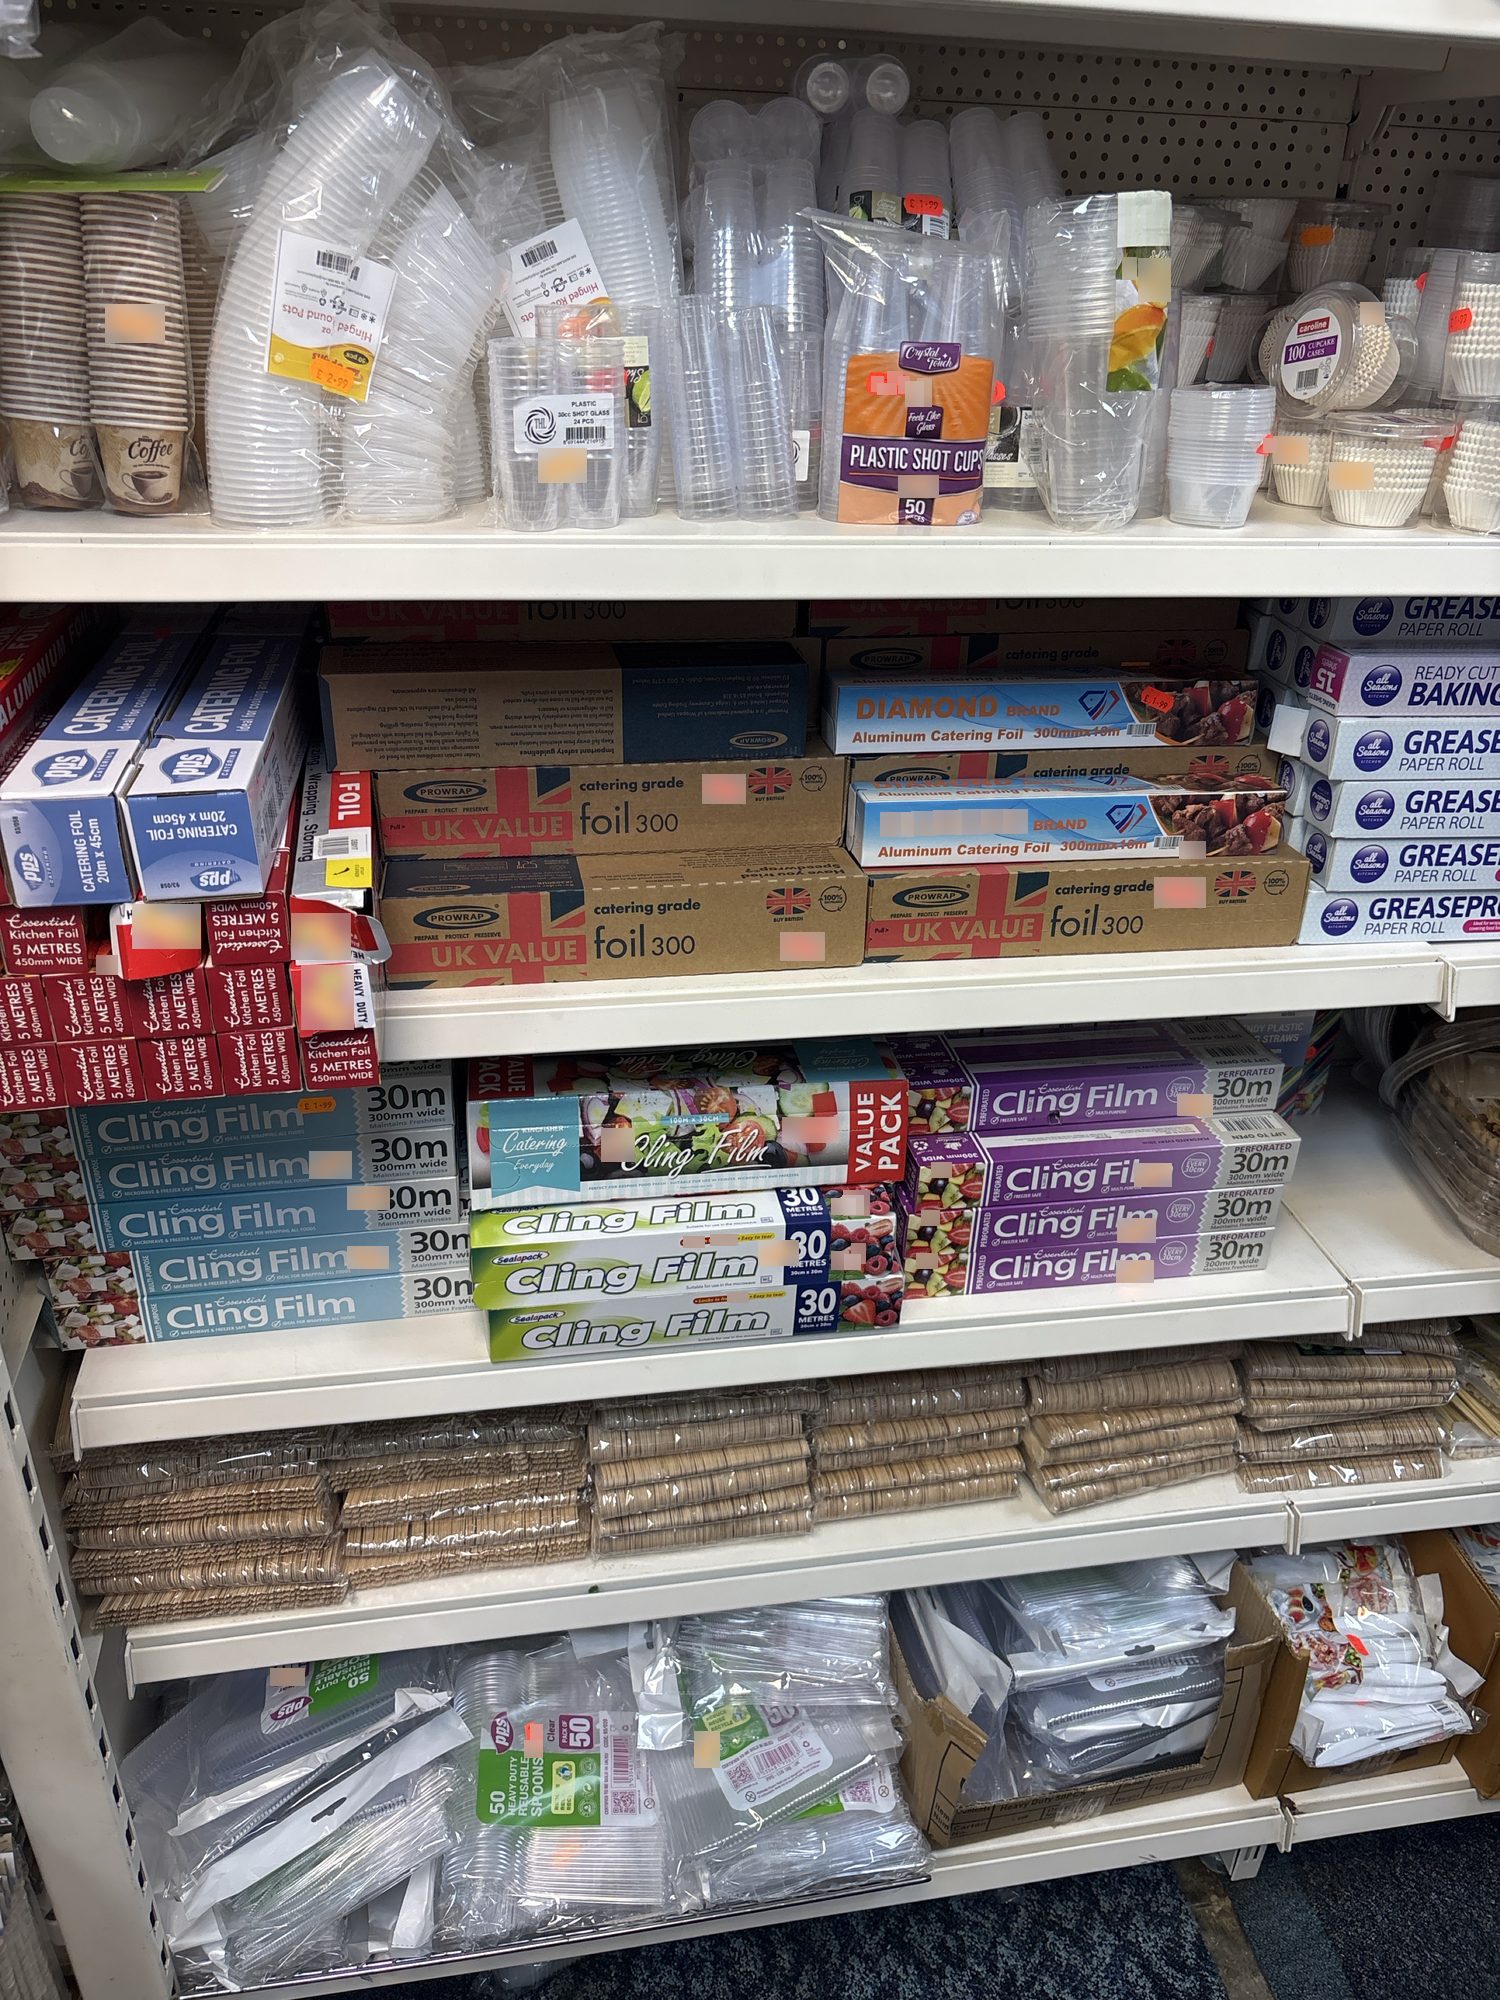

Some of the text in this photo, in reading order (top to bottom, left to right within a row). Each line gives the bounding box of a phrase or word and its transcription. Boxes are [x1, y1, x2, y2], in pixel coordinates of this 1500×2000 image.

[569, 282, 599, 304] Hinged
[282, 303, 372, 343] Hinged ound Pots
[1298, 320, 1328, 334] caroline
[906, 347, 940, 359] Crystal
[1287, 338, 1336, 362] 100 CUPCAKE
[1307, 348, 1325, 357] CASES
[927, 358, 953, 369] Touch
[908, 411, 941, 422] Feels Like
[916, 422, 935, 435] Glass
[128, 439, 173, 462] Coffee
[850, 445, 908, 469] PLASTIC
[912, 448, 950, 471] SHOT
[905, 500, 925, 515] 50
[1414, 666, 1500, 680] READY CUT
[184, 664, 253, 733] CATERING
[855, 694, 1061, 721] DIAMOND BRAND
[851, 727, 1024, 744] Aluminum Catering Foil
[44, 754, 92, 779] pps
[171, 753, 213, 776] pps
[302, 773, 322, 815] Wrapping
[419, 785, 471, 799] PROWRAP
[579, 777, 684, 793] catering grade
[338, 782, 360, 821] FOIL
[421, 815, 564, 842] UK VALUE
[579, 801, 679, 836] foil 300
[88, 818, 99, 849] 45cm
[298, 823, 318, 862] Storing
[69, 810, 96, 893] CATERING FOIL
[24, 852, 42, 882] pps
[96, 863, 110, 883] 20m
[199, 871, 230, 886] pps
[1369, 896, 1500, 920] GREASEPR
[6, 914, 76, 929] Essential
[1364, 921, 1445, 935] PAPER ROLL
[9, 929, 79, 939] Kitchen Foil
[13, 942, 81, 955] 5 METRES
[15, 957, 83, 966] 450mm WIDE
[220, 971, 241, 1028] Essential
[235, 970, 253, 1025] Kitchen Foil
[251, 968, 268, 1015] METRES
[266, 968, 282, 1022] 450mm WIDE
[354, 969, 368, 1023] HEAVY DUTY
[367, 1084, 446, 1112] 30m
[992, 1083, 1158, 1116] Cling Film
[1038, 1083, 1084, 1094] Essential
[369, 1108, 446, 1122] 300mm wide
[979, 1089, 990, 1126] PERFORATED
[854, 1092, 875, 1173] VALUE
[877, 1090, 903, 1171] PACK
[502, 1131, 568, 1154] Catering
[621, 1127, 770, 1180] Cling Film
[1234, 1143, 1292, 1153] PERFORATED
[513, 1159, 555, 1172] Everyday
[1230, 1152, 1289, 1174] 30m
[1227, 1172, 1261, 1181] 300mm
[496, 1251, 543, 1264] Sealapack
[504, 1251, 759, 1295] Cling Film
[166, 1293, 356, 1328] Cling Film
[214, 1295, 267, 1307] Essential
[799, 1287, 836, 1316] 30
[798, 1314, 834, 1323] METRES
[348, 1672, 369, 1688] 50
[277, 1698, 304, 1718] pps
[495, 1718, 509, 1746] pps
[547, 1720, 555, 1742] Clear
[569, 1718, 591, 1748] 50
[508, 1757, 518, 1816] HEAVY DUTY
[518, 1757, 529, 1816] REUSABLE
[531, 1758, 544, 1817] SPOONS
[490, 1791, 505, 1814] 50
